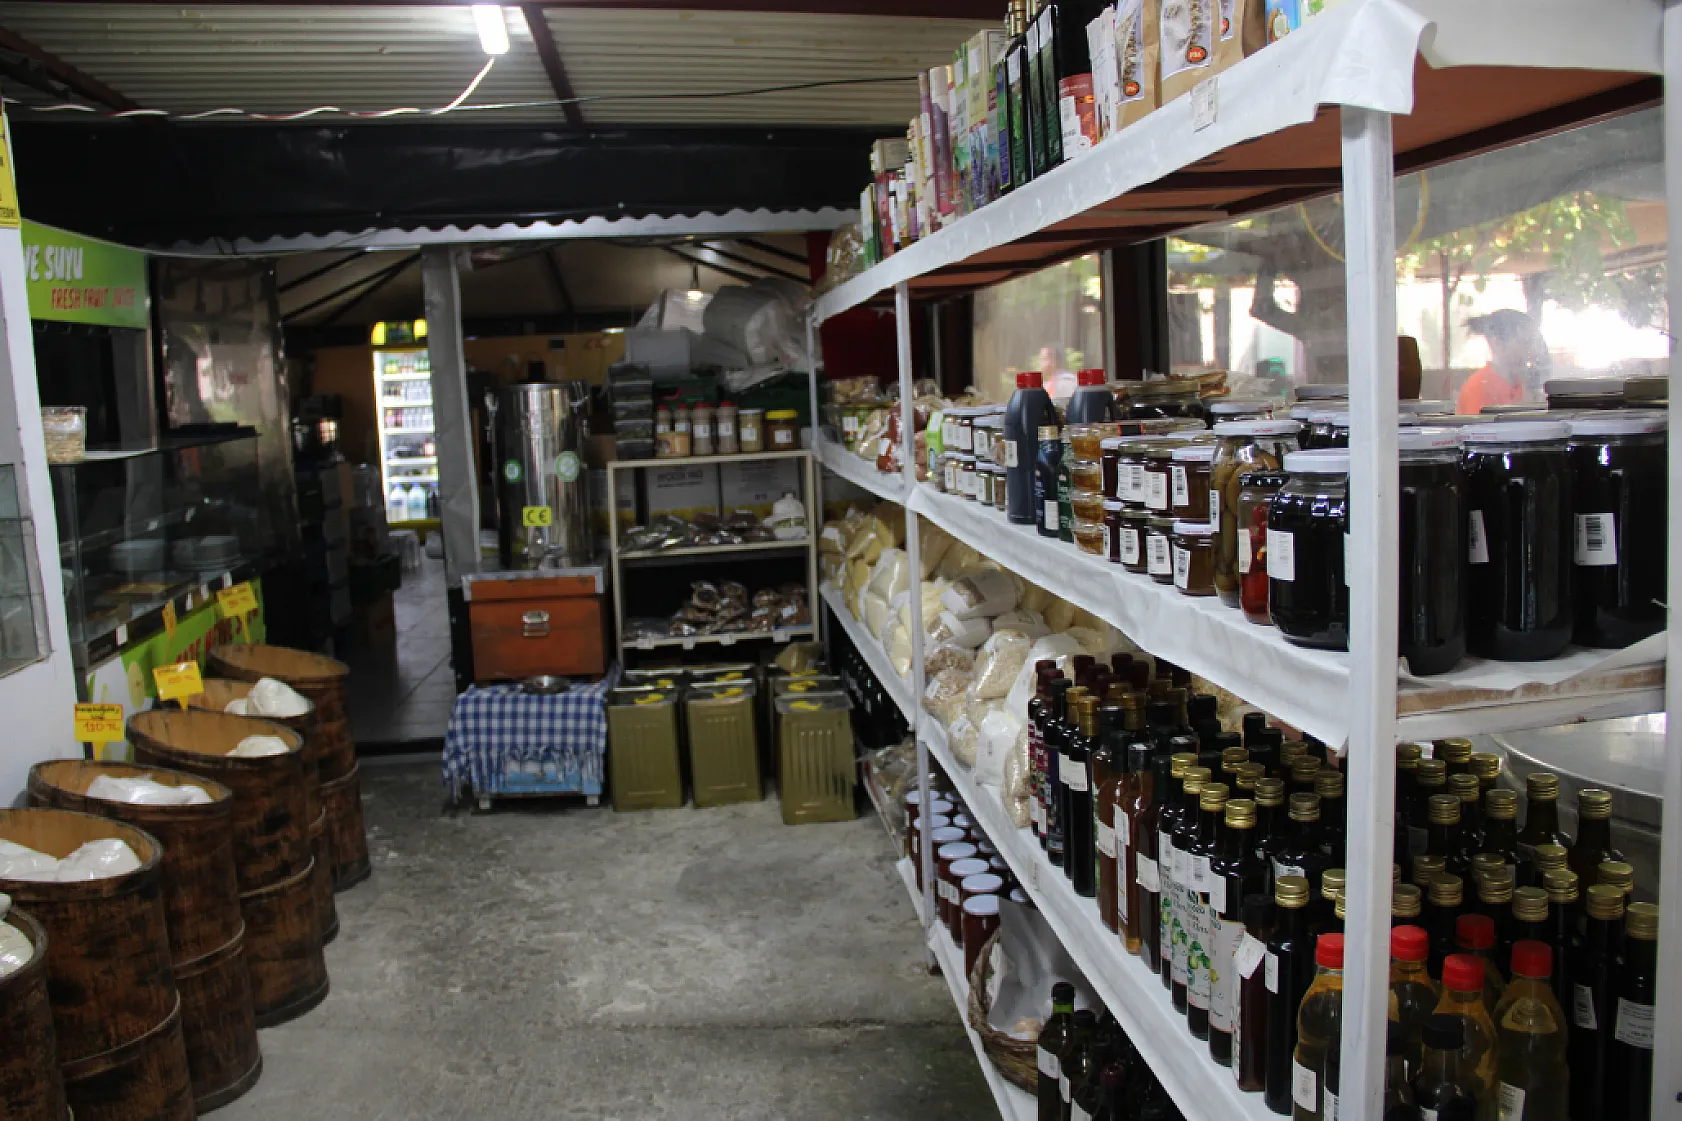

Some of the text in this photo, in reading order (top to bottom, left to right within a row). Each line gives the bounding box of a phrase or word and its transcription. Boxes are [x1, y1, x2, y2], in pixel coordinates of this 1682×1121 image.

[44, 245, 84, 281] SUYU
[51, 287, 81, 310] FRESH
[84, 287, 109, 308] FRUIT
[525, 509, 547, 524] CE
